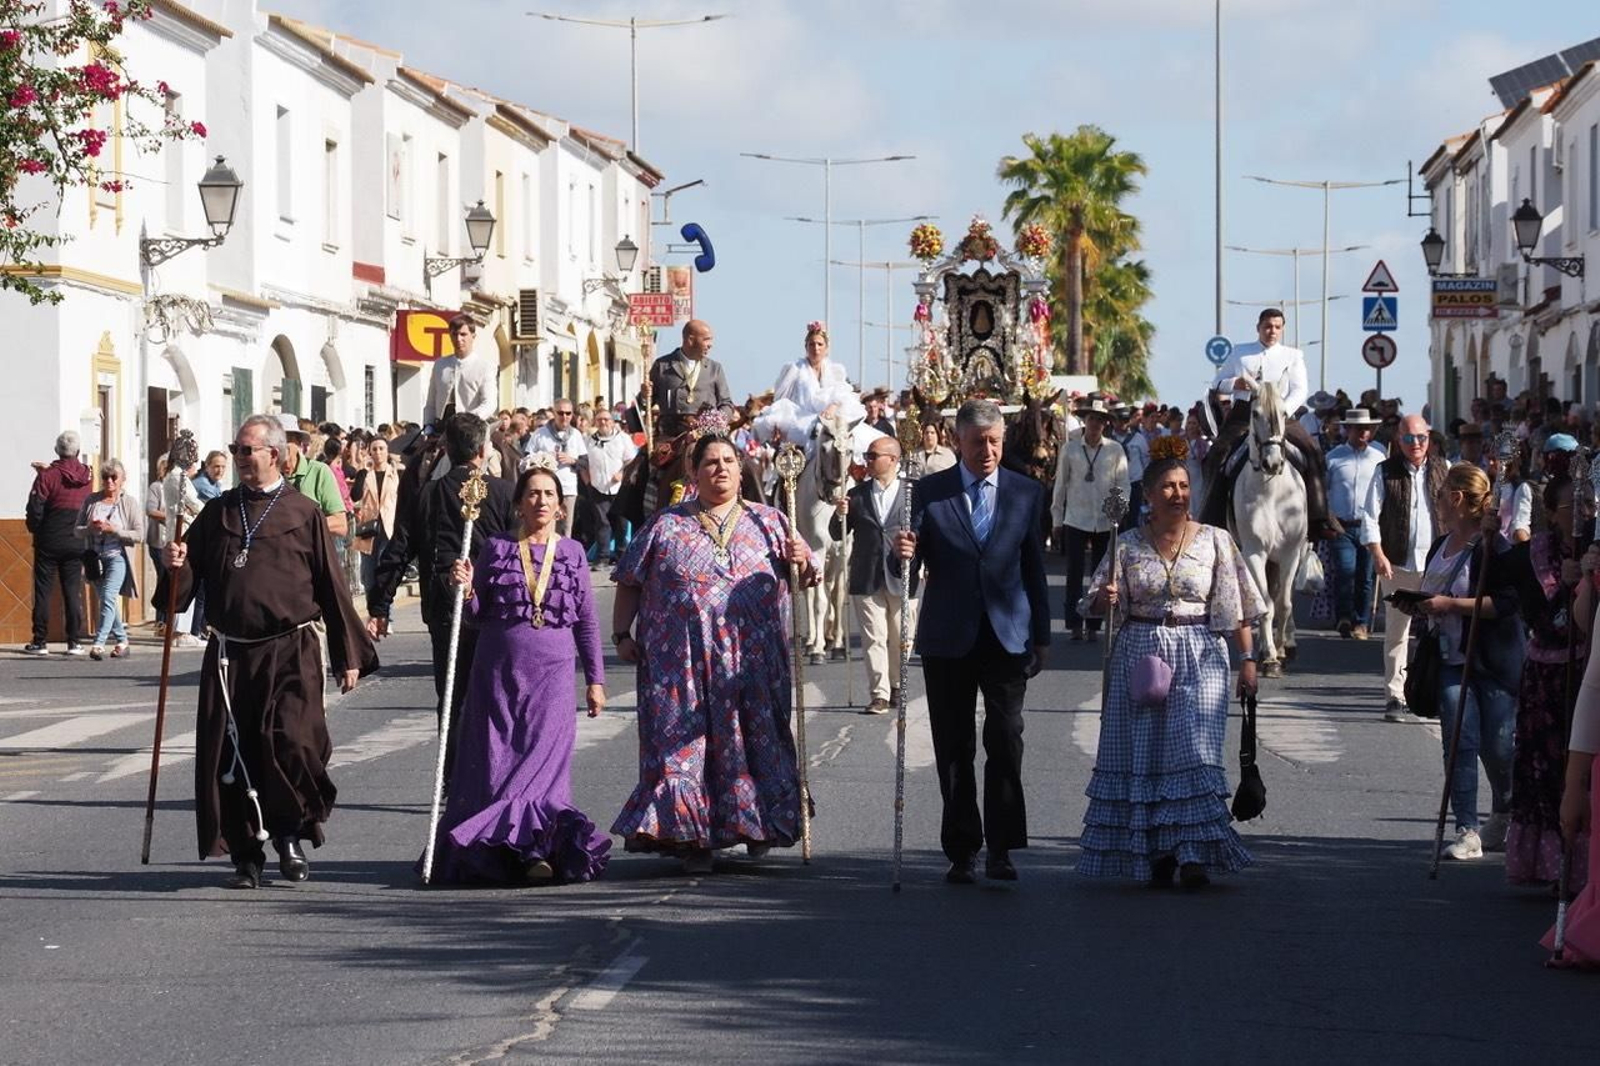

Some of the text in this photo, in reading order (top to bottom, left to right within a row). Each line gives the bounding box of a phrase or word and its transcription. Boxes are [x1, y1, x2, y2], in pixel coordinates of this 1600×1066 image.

[1435, 281, 1495, 290] MAGAZIN
[633, 296, 671, 305] ABIERTO
[1437, 294, 1493, 304] PALOS
[631, 305, 652, 315] 24
